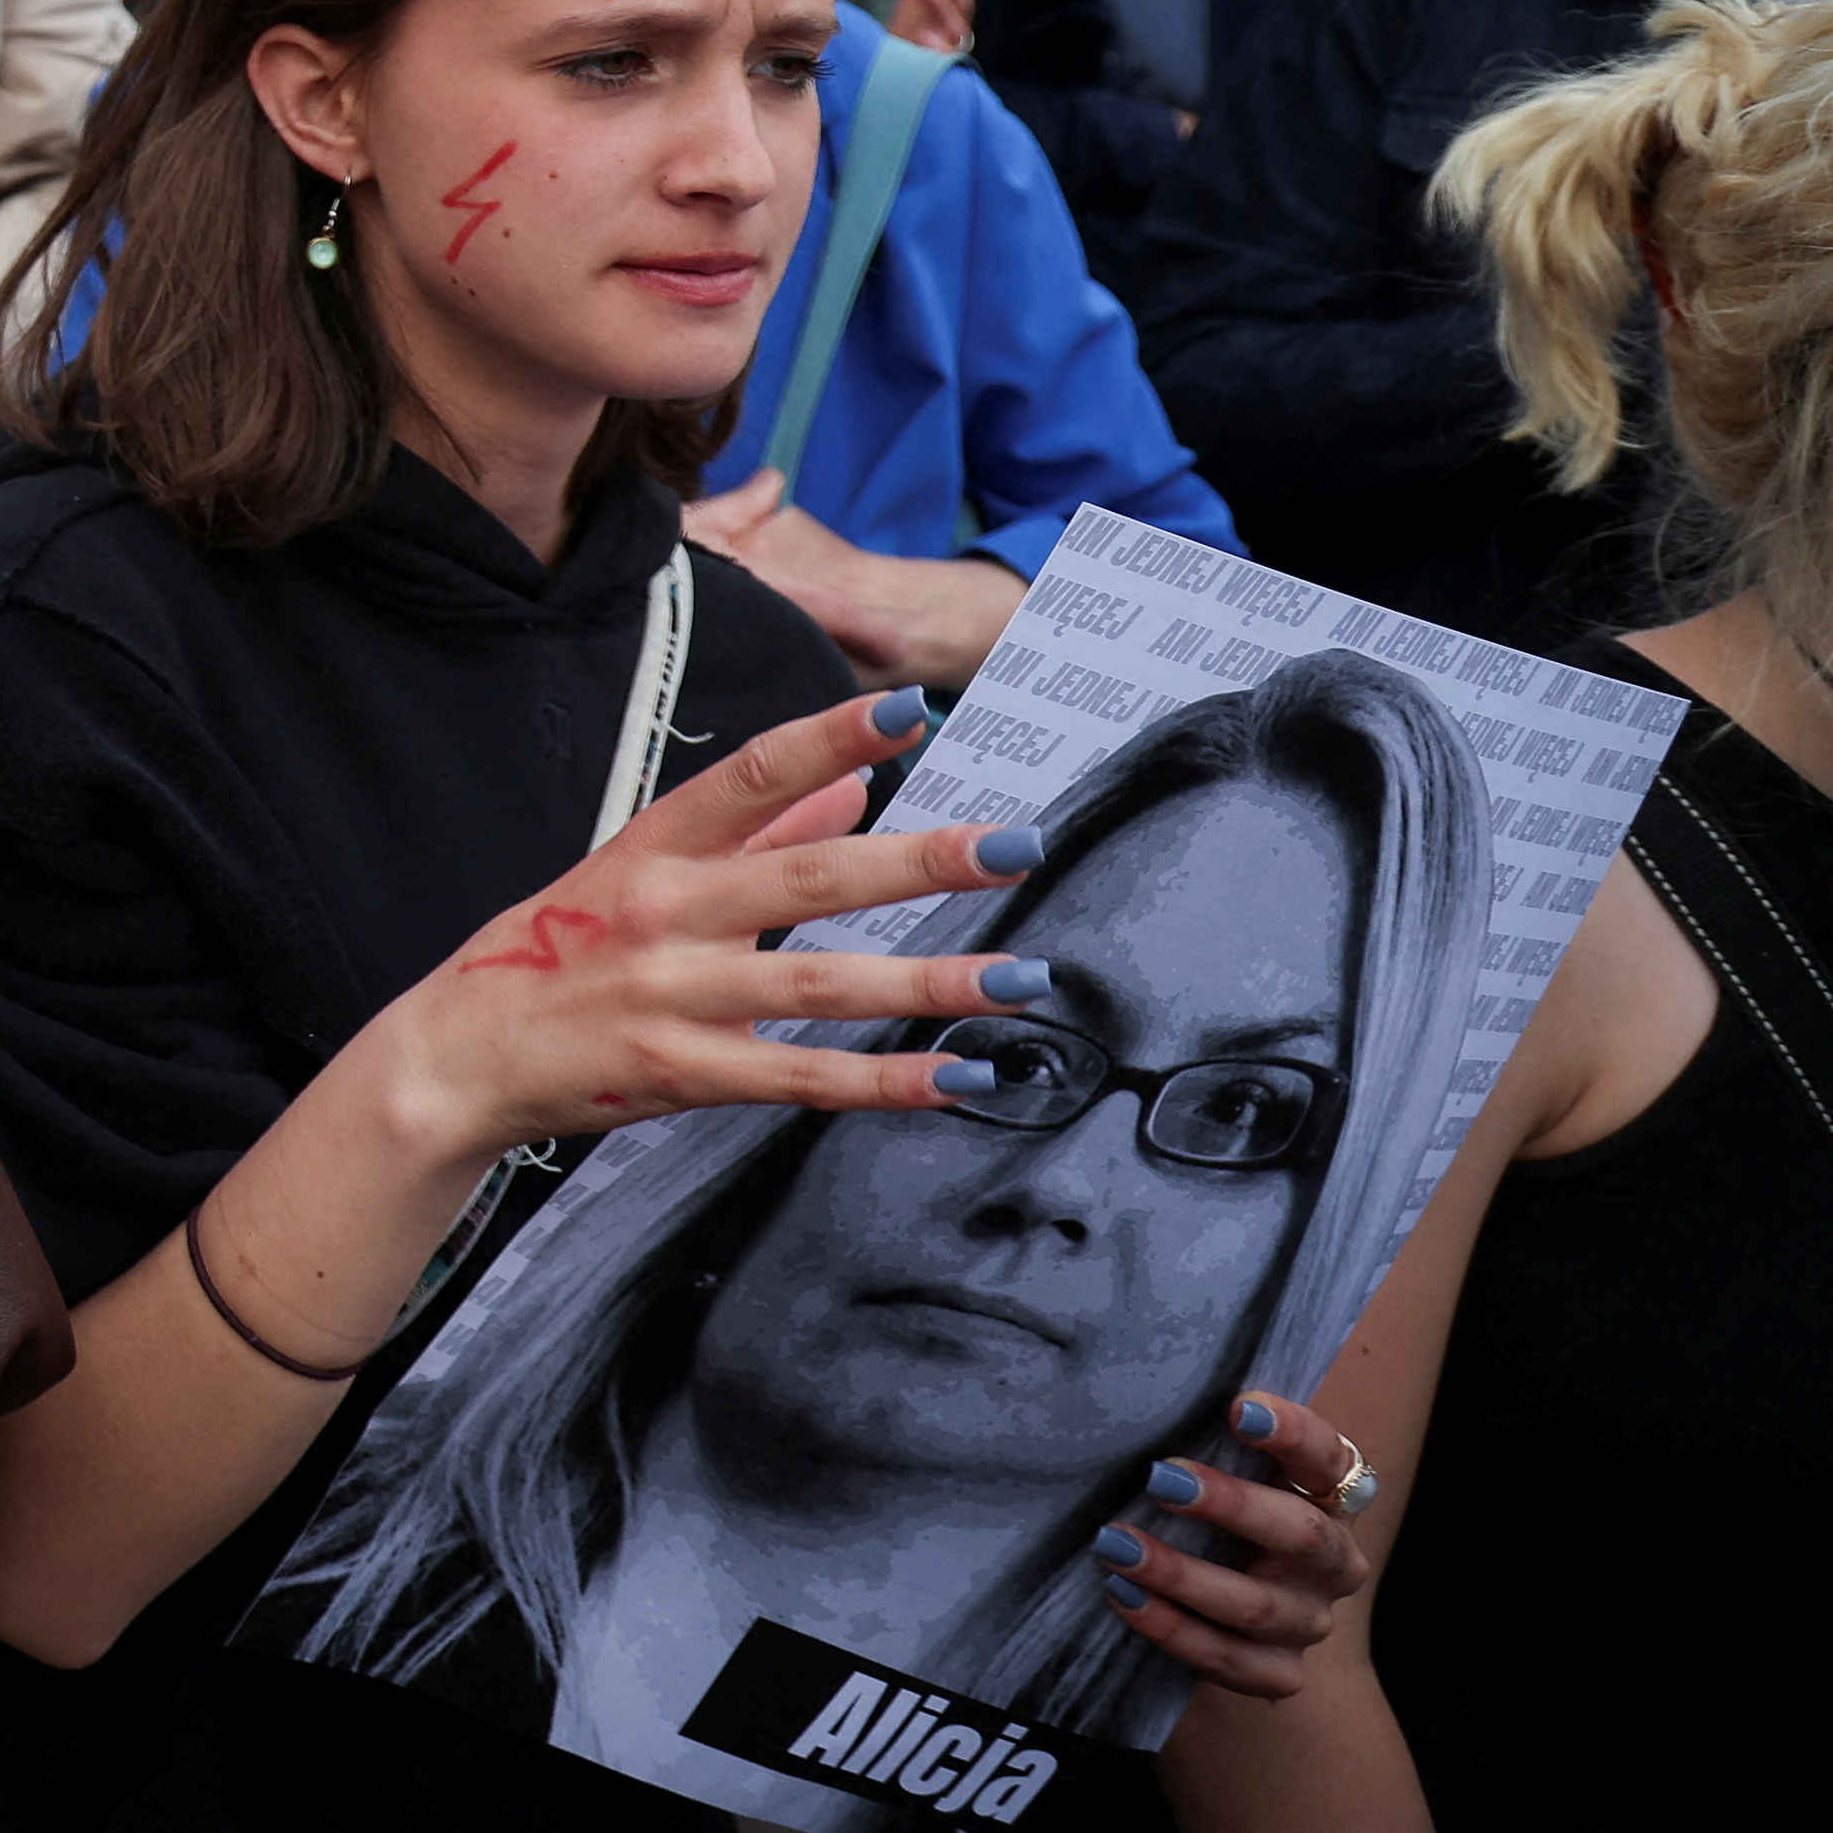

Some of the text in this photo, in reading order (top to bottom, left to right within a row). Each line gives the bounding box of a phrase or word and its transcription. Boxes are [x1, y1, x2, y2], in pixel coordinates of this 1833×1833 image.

[1059, 511, 1126, 559] ANI
[1110, 530, 1230, 595] JEDNEJ
[1216, 563, 1326, 627] WIĘCEJ
[1327, 603, 1387, 649] ANI
[1373, 619, 1469, 674] JEDNEJ
[1456, 641, 1540, 701] WIĘCEJ
[943, 704, 1066, 768] WIĘCEJ
[984, 642, 1046, 690] ANI
[1032, 662, 1153, 723] JEDNEJ
[1024, 574, 1145, 640] WIĘCEJ
[1147, 618, 1214, 664] ANI
[1512, 728, 1586, 784] WIĘCEJ
[896, 768, 965, 814] ANI
[787, 1670, 1059, 1825] Alicja
